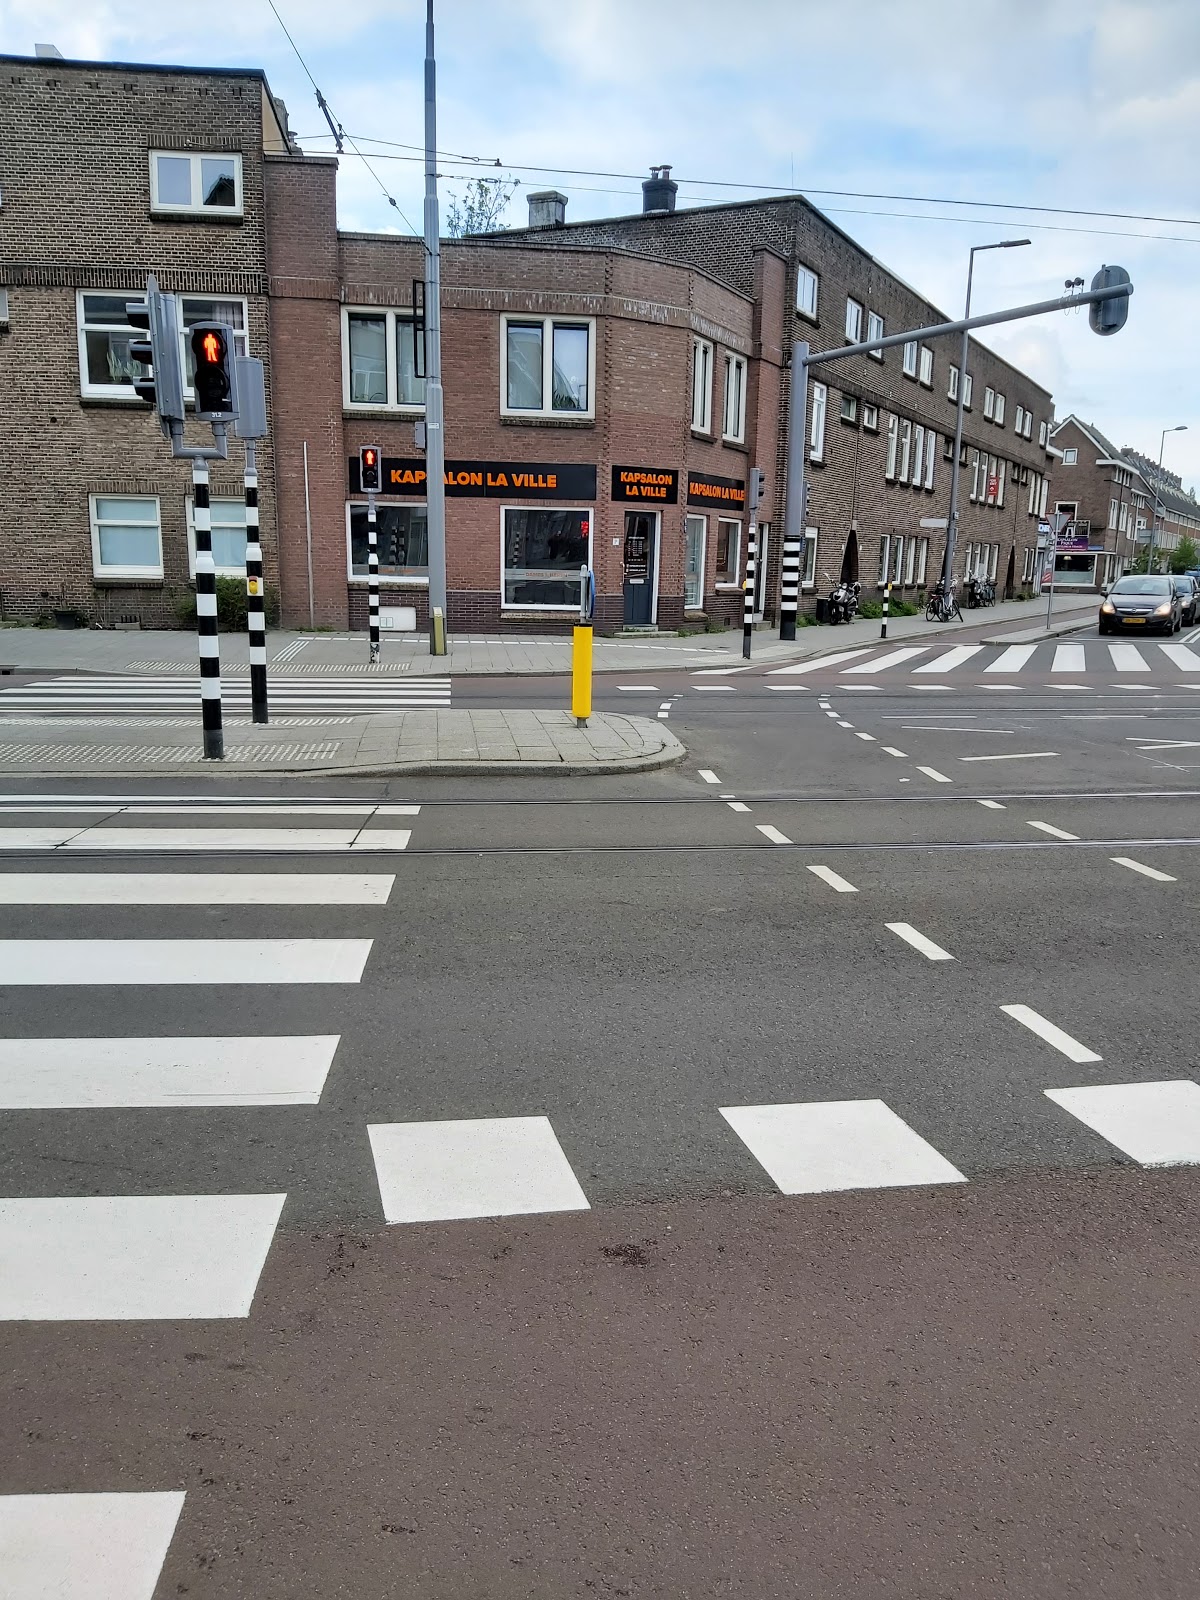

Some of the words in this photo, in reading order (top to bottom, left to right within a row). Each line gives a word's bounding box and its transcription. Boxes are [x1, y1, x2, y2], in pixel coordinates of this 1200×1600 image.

[391, 470, 482, 485] KAPLON
[487, 473, 508, 487] LA
[512, 474, 557, 488] VILLE
[620, 472, 673, 485] KAPSALON
[626, 485, 638, 496] LA
[641, 486, 667, 498] VILLE
[689, 482, 722, 498] KAPSALON
[721, 488, 729, 499] LA
[729, 489, 745, 501] VILLE
